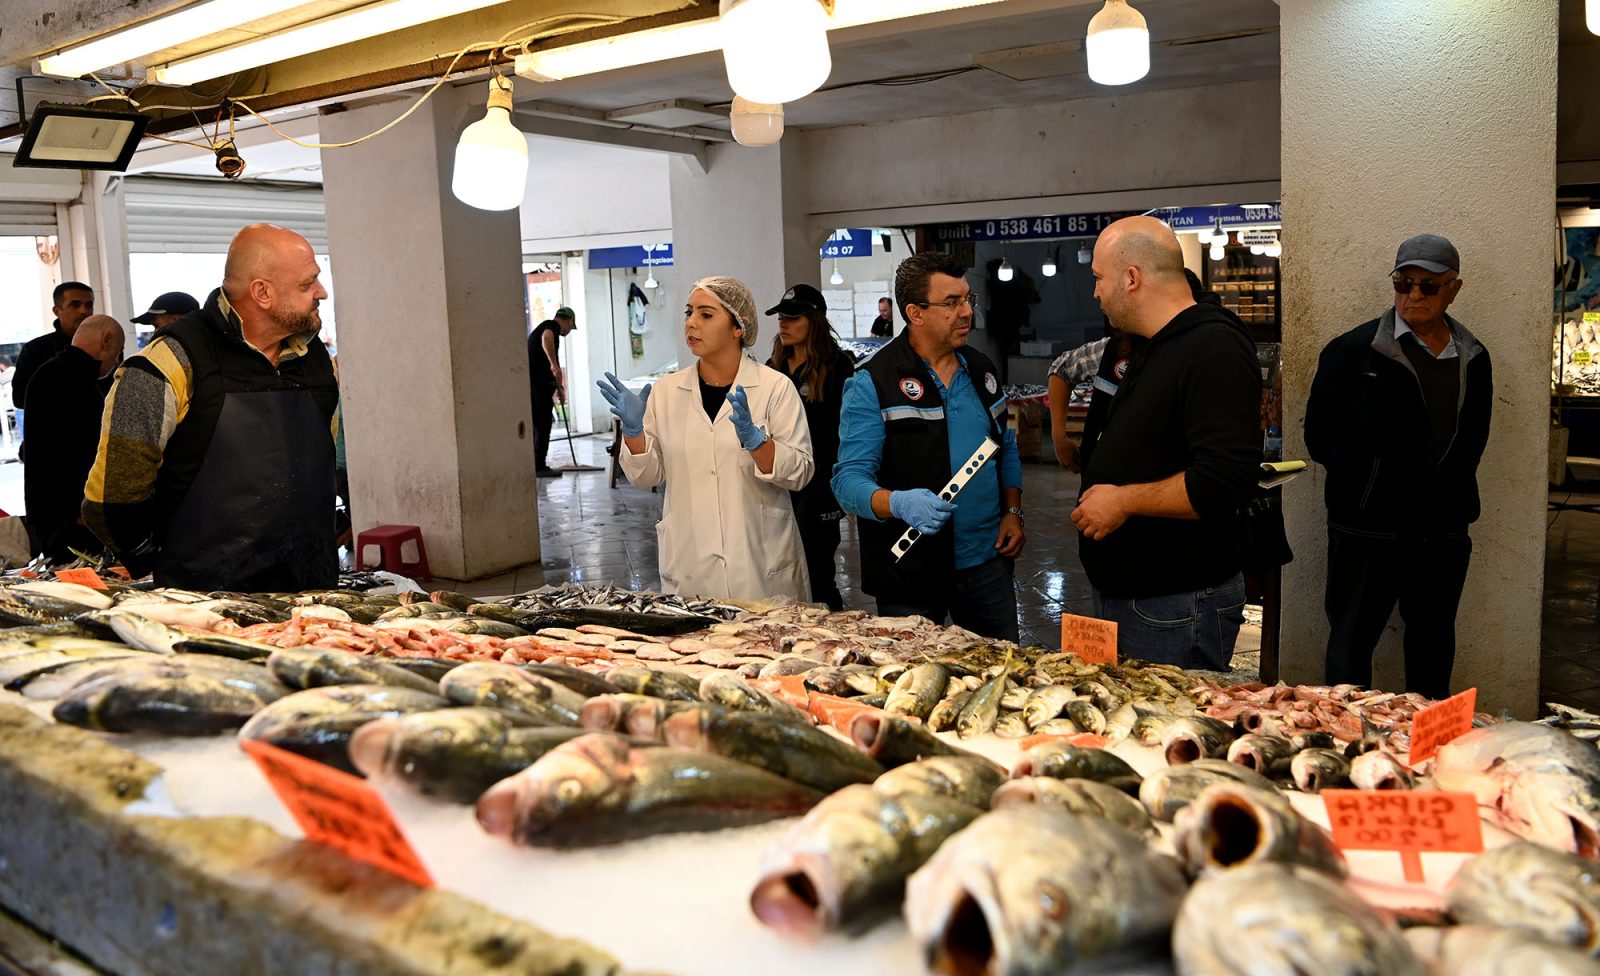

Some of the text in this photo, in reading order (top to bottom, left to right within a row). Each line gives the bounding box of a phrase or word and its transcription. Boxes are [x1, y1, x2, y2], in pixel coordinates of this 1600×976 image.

[986, 222, 995, 236] 0
[1000, 220, 1028, 235] 538
[1033, 218, 1061, 234] 461
[1068, 216, 1087, 232] 85
[841, 246, 854, 255] 07
